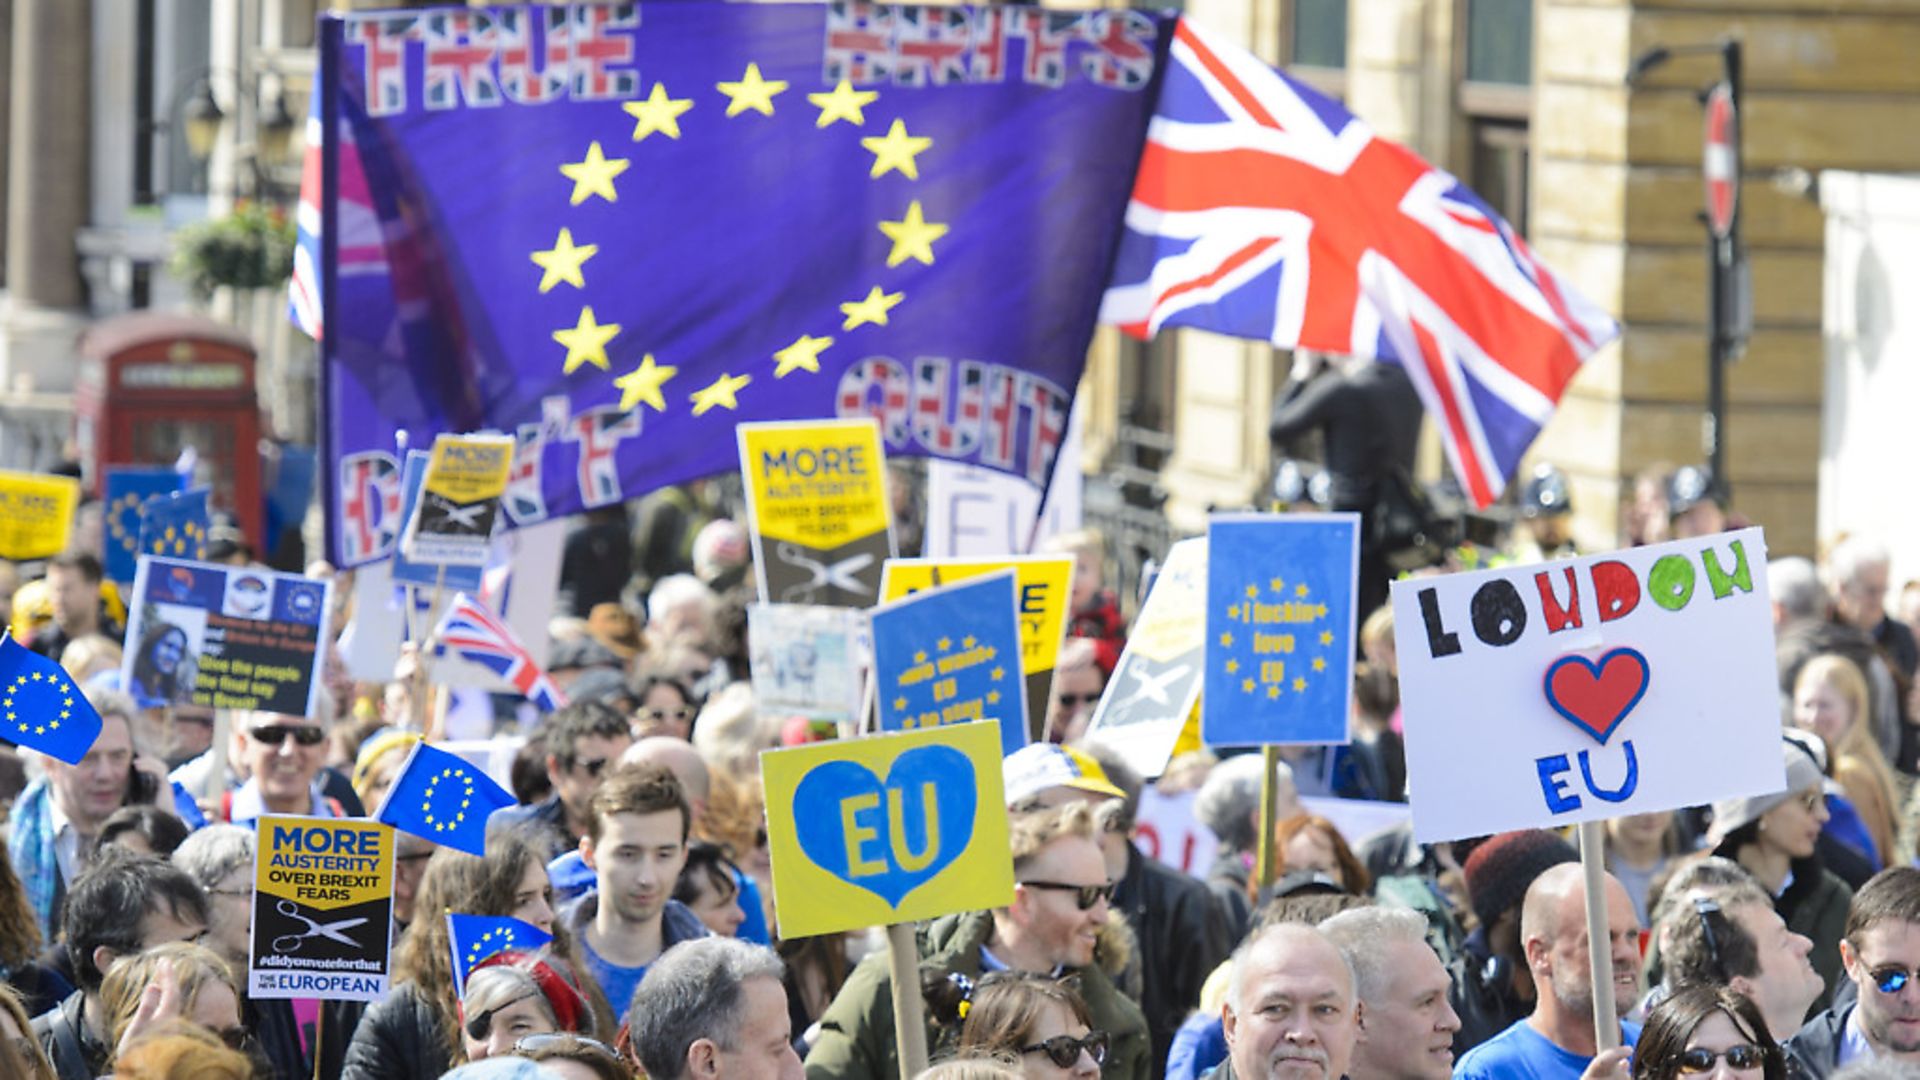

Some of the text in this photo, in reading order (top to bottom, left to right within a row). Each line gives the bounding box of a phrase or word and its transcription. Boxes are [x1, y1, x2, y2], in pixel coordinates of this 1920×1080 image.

[344, 2, 1158, 117] TRUE BRITS
[835, 355, 1069, 489] QUIT
[762, 446, 866, 477] MORE
[767, 480, 871, 499] AUSTERITY
[1253, 632, 1295, 654] love
[199, 655, 301, 683] Give the people
[1261, 661, 1284, 683] EU
[195, 673, 217, 689] the
[251, 681, 277, 700] say
[933, 678, 956, 701] EU
[919, 711, 940, 729] to
[1535, 740, 1639, 815] EU
[273, 826, 380, 855] MORE
[840, 782, 940, 878] EU
[270, 853, 380, 872] AUSTERITY
[269, 870, 380, 888] OVER BREXIT
[297, 887, 350, 900] FEARS
[259, 955, 381, 971] #didyouvoteforthat
[259, 974, 276, 982] THE
[278, 974, 380, 993] EUROPEAN
